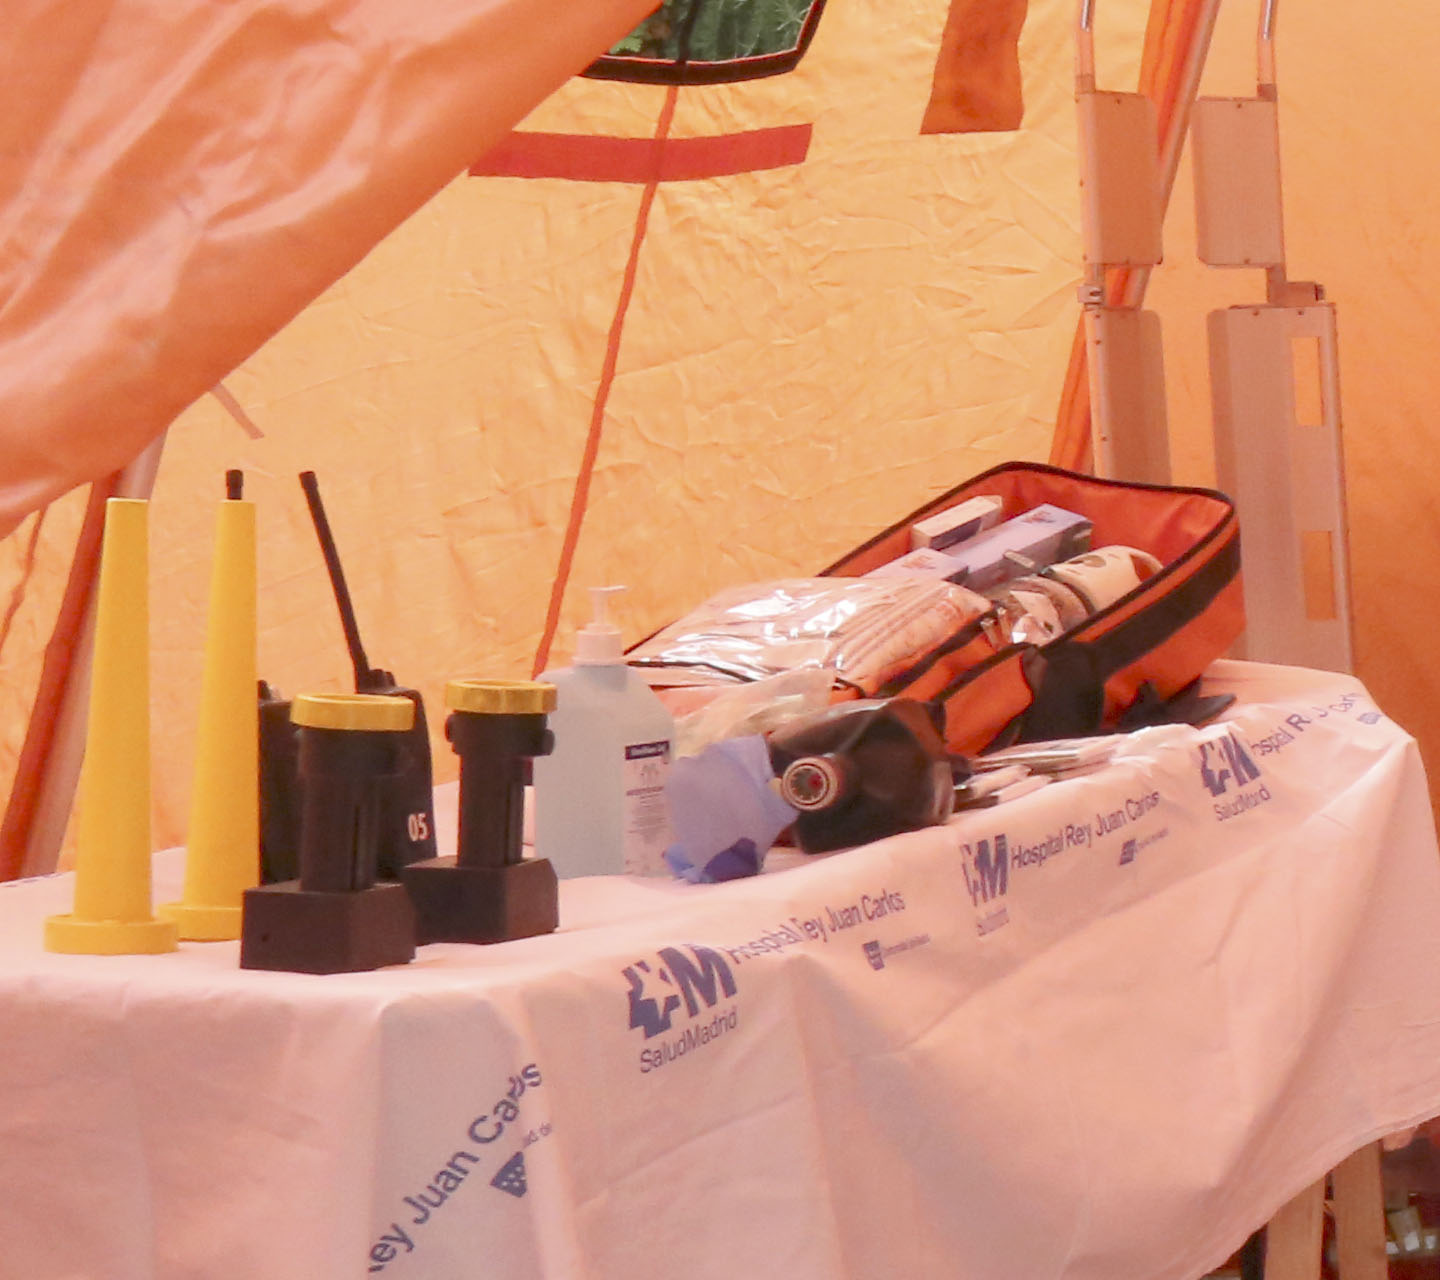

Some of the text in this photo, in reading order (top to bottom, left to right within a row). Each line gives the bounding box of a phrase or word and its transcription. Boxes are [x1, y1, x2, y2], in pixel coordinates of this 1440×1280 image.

[408, 813, 428, 842] 05
[1010, 829, 1065, 868] Hospital
[1064, 823, 1092, 848] Rey
[1094, 813, 1128, 837] Juan
[824, 906, 863, 932] Juan
[862, 889, 906, 921] Carlos
[639, 1006, 739, 1073] SaludMadrid
[368, 1223, 415, 1273] ey
[403, 1151, 480, 1225] Juan
[468, 1063, 543, 1145] Caos
